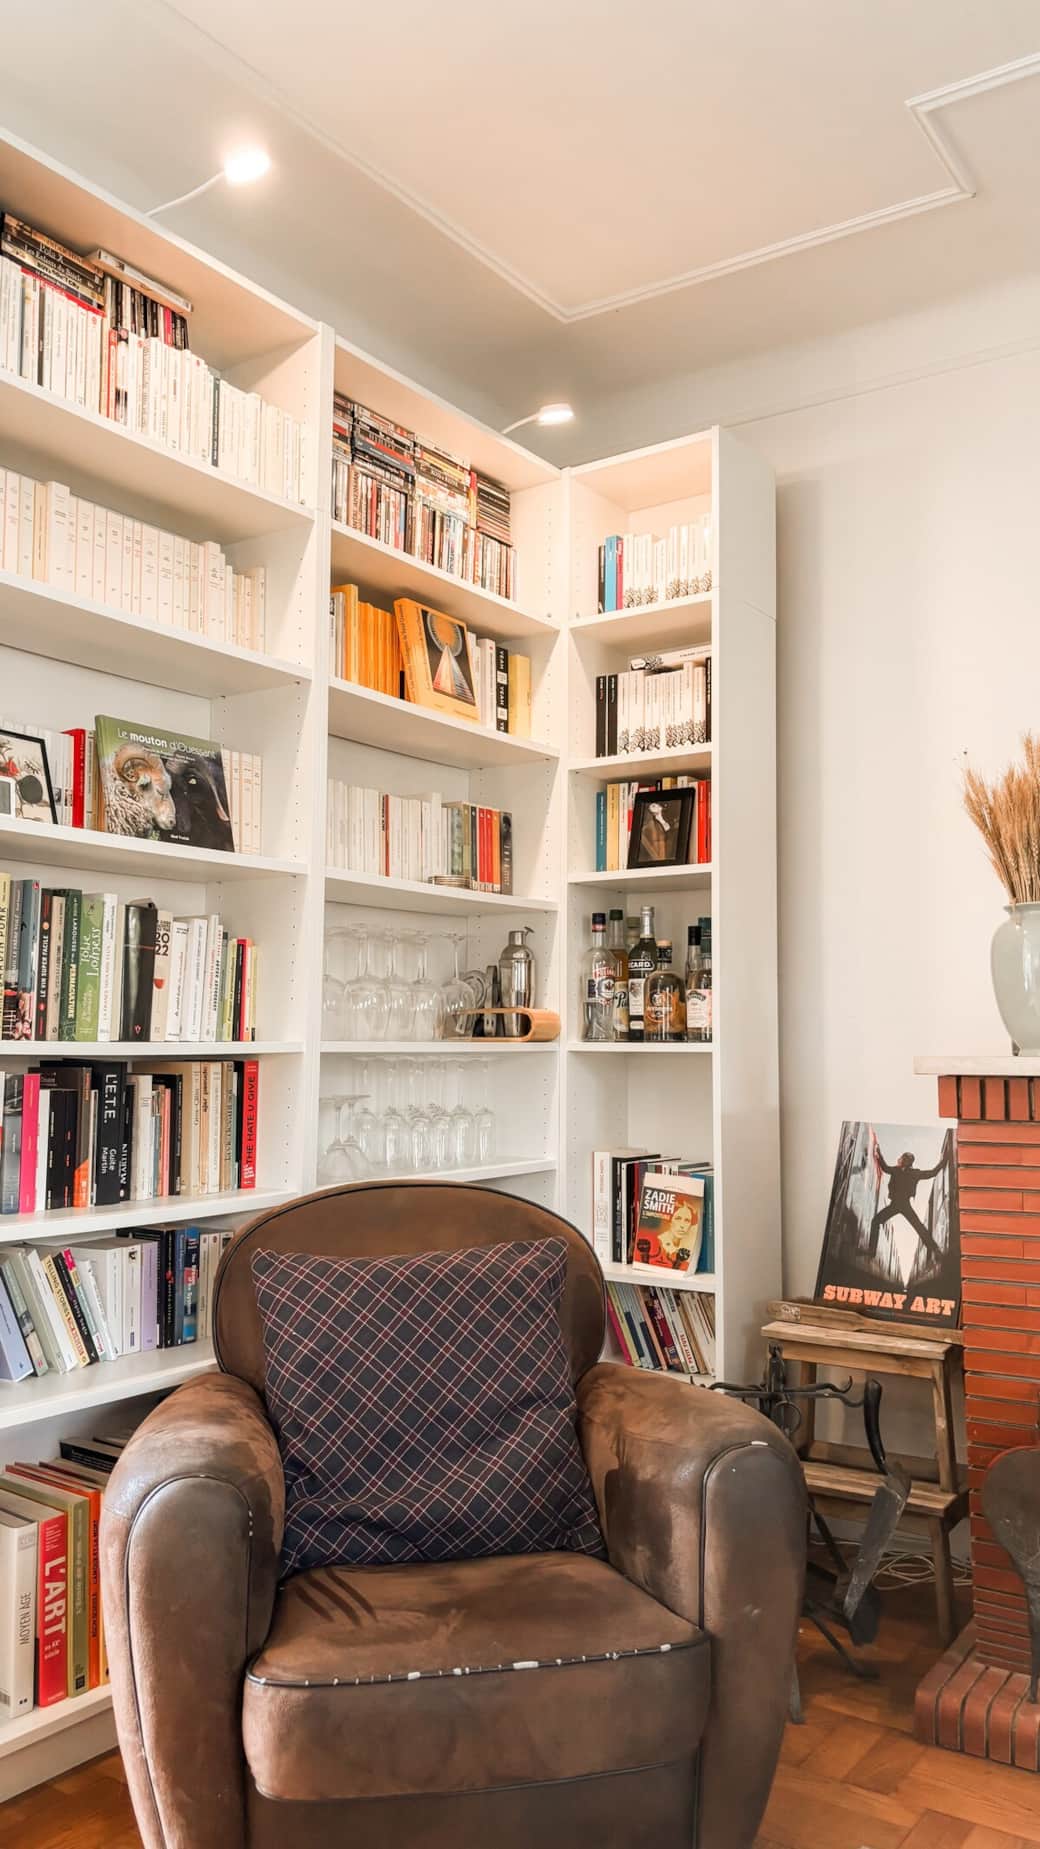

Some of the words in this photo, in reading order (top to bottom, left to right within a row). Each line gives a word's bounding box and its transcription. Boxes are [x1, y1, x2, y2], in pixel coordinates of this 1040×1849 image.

[117, 728, 128, 739] Le
[129, 733, 168, 748] mouton
[154, 944, 169, 956] 22
[40, 988, 46, 998] LE
[247, 1076, 255, 1102] GIVE
[247, 1105, 255, 1113] U
[246, 1116, 255, 1141] HATE
[101, 1147, 109, 1174] Martin
[108, 1148, 117, 1171] Guite
[245, 1145, 255, 1164] THE
[643, 1200, 675, 1215] SMITH
[644, 1189, 676, 1204] ZADIE
[46, 1260, 60, 1286] TELLING
[56, 1289, 71, 1319] STORIES
[823, 1284, 907, 1310] SUBWAY
[910, 1295, 956, 1316] ART
[44, 1555, 66, 1638] L'ART
[19, 1611, 31, 1645] MOYEN
